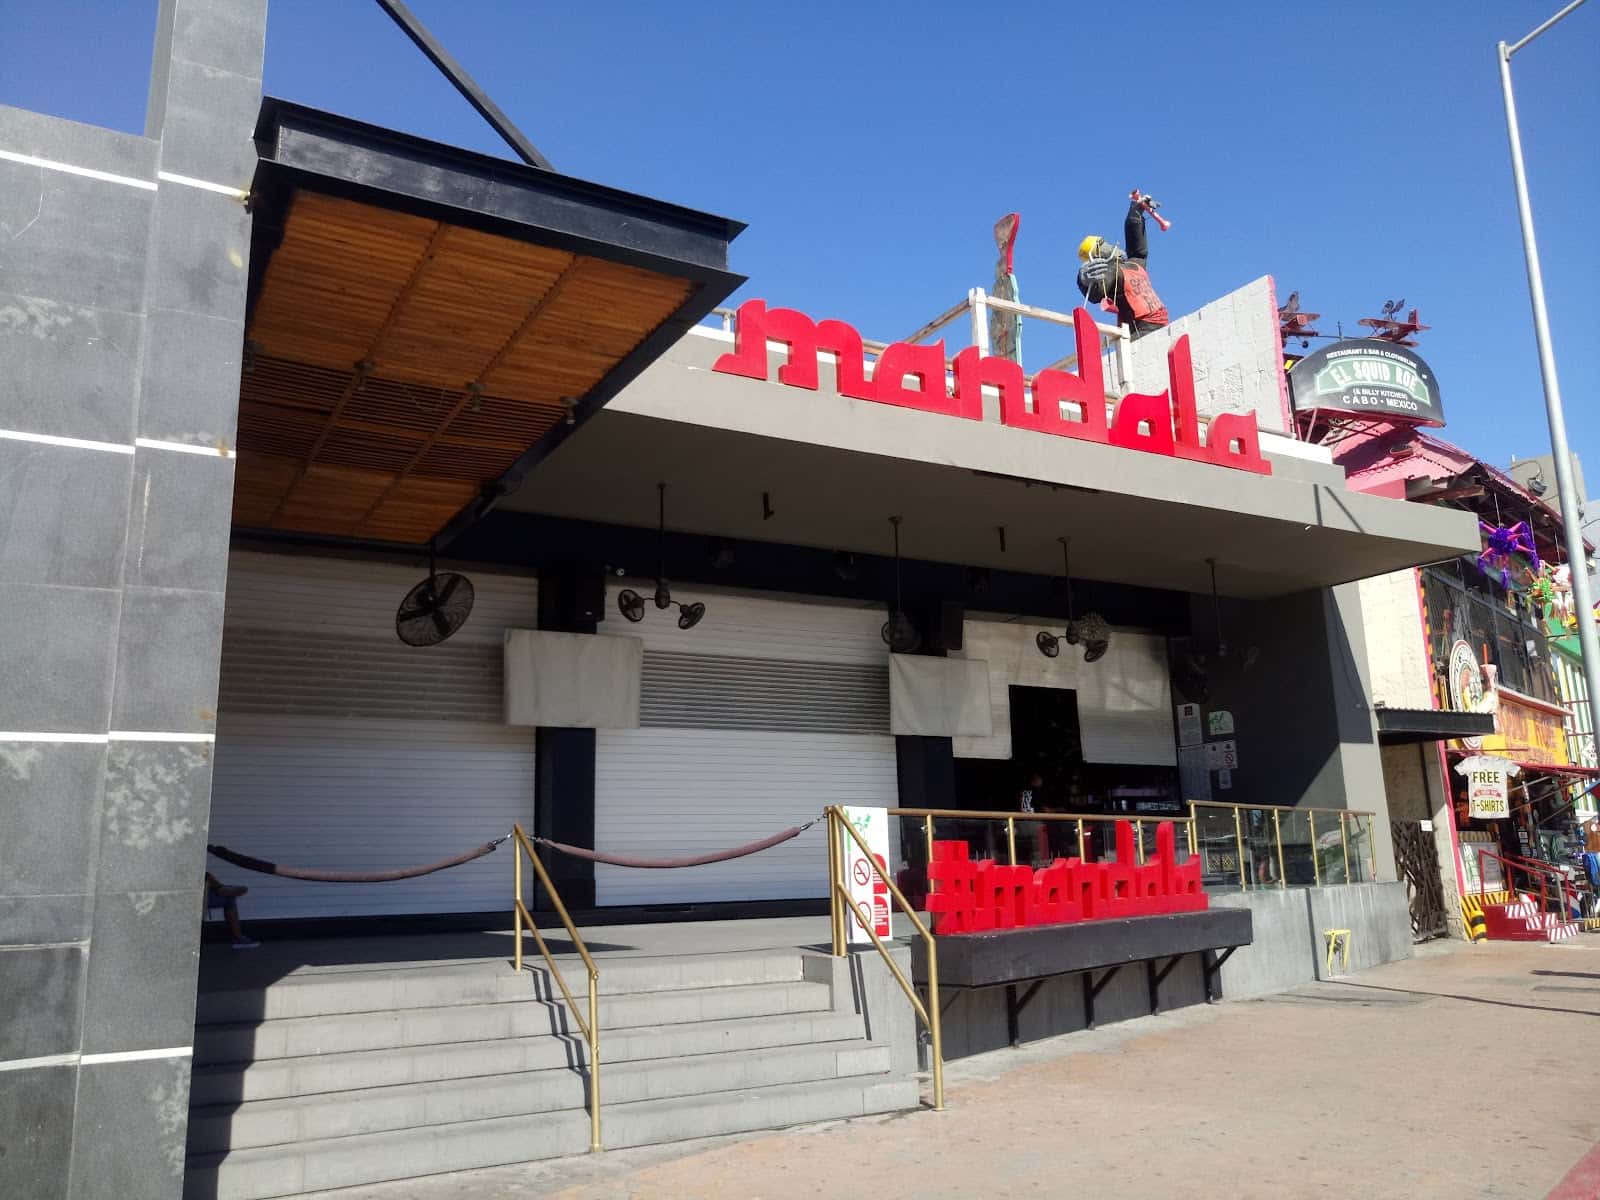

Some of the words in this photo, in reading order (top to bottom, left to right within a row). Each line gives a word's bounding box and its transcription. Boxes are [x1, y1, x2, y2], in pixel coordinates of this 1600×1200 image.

[1326, 349, 1362, 359] RESTAURANT
[1329, 365, 1352, 385] EL
[1352, 360, 1391, 384] SQUID
[1395, 366, 1417, 392] ROE
[711, 298, 1272, 476] mandala
[1343, 395, 1379, 405] CABO
[1386, 398, 1418, 411] MEXICO
[1472, 771, 1500, 783] FREE
[1472, 799, 1504, 812] T-SHIRTS
